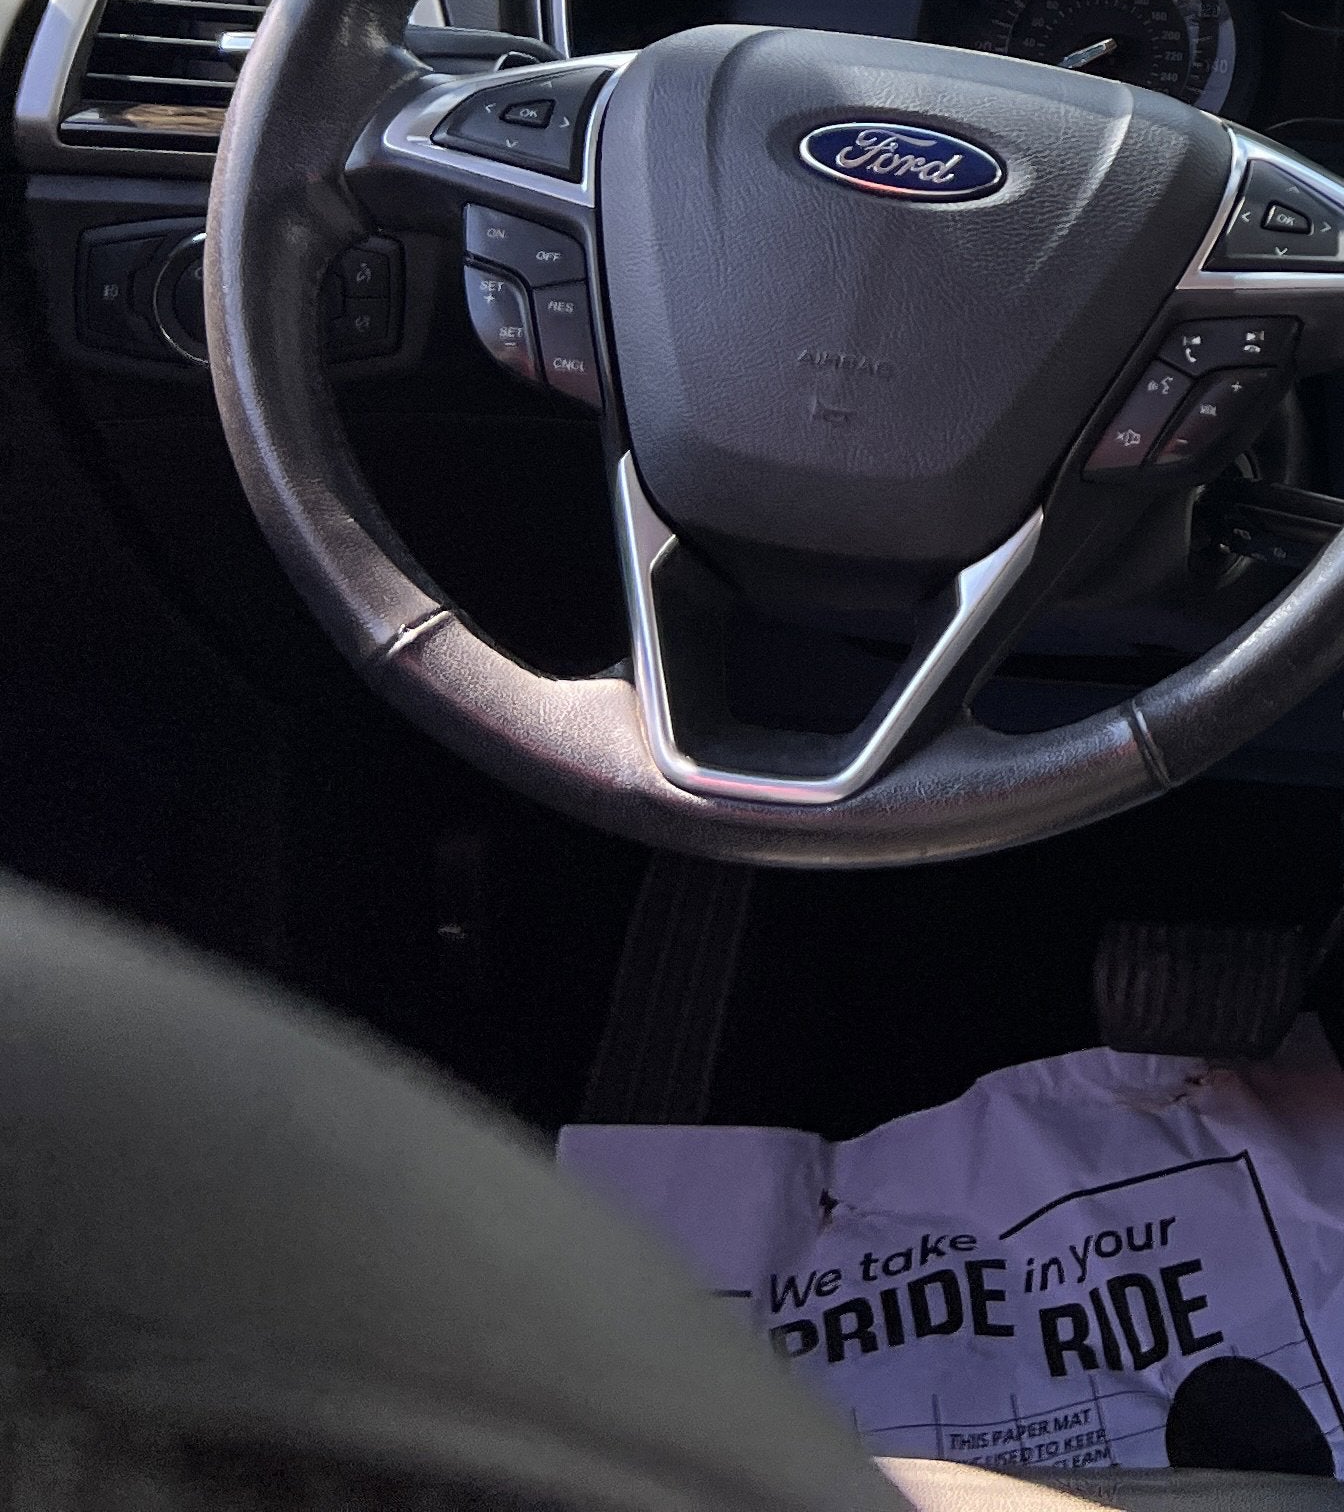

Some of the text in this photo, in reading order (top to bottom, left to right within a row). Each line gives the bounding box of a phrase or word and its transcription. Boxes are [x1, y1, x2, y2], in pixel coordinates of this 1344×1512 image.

[834, 129, 964, 184] Ford
[535, 251, 561, 262] OFF
[480, 280, 504, 291] SET
[769, 1232, 979, 1315] We take
[1024, 1216, 1177, 1295] in your
[769, 1258, 1015, 1363] PRIDE
[1039, 1258, 1225, 1378] RIDE
[949, 1408, 1093, 1451] THIS PAPER MAT
[1036, 1441, 1059, 1459] TO
